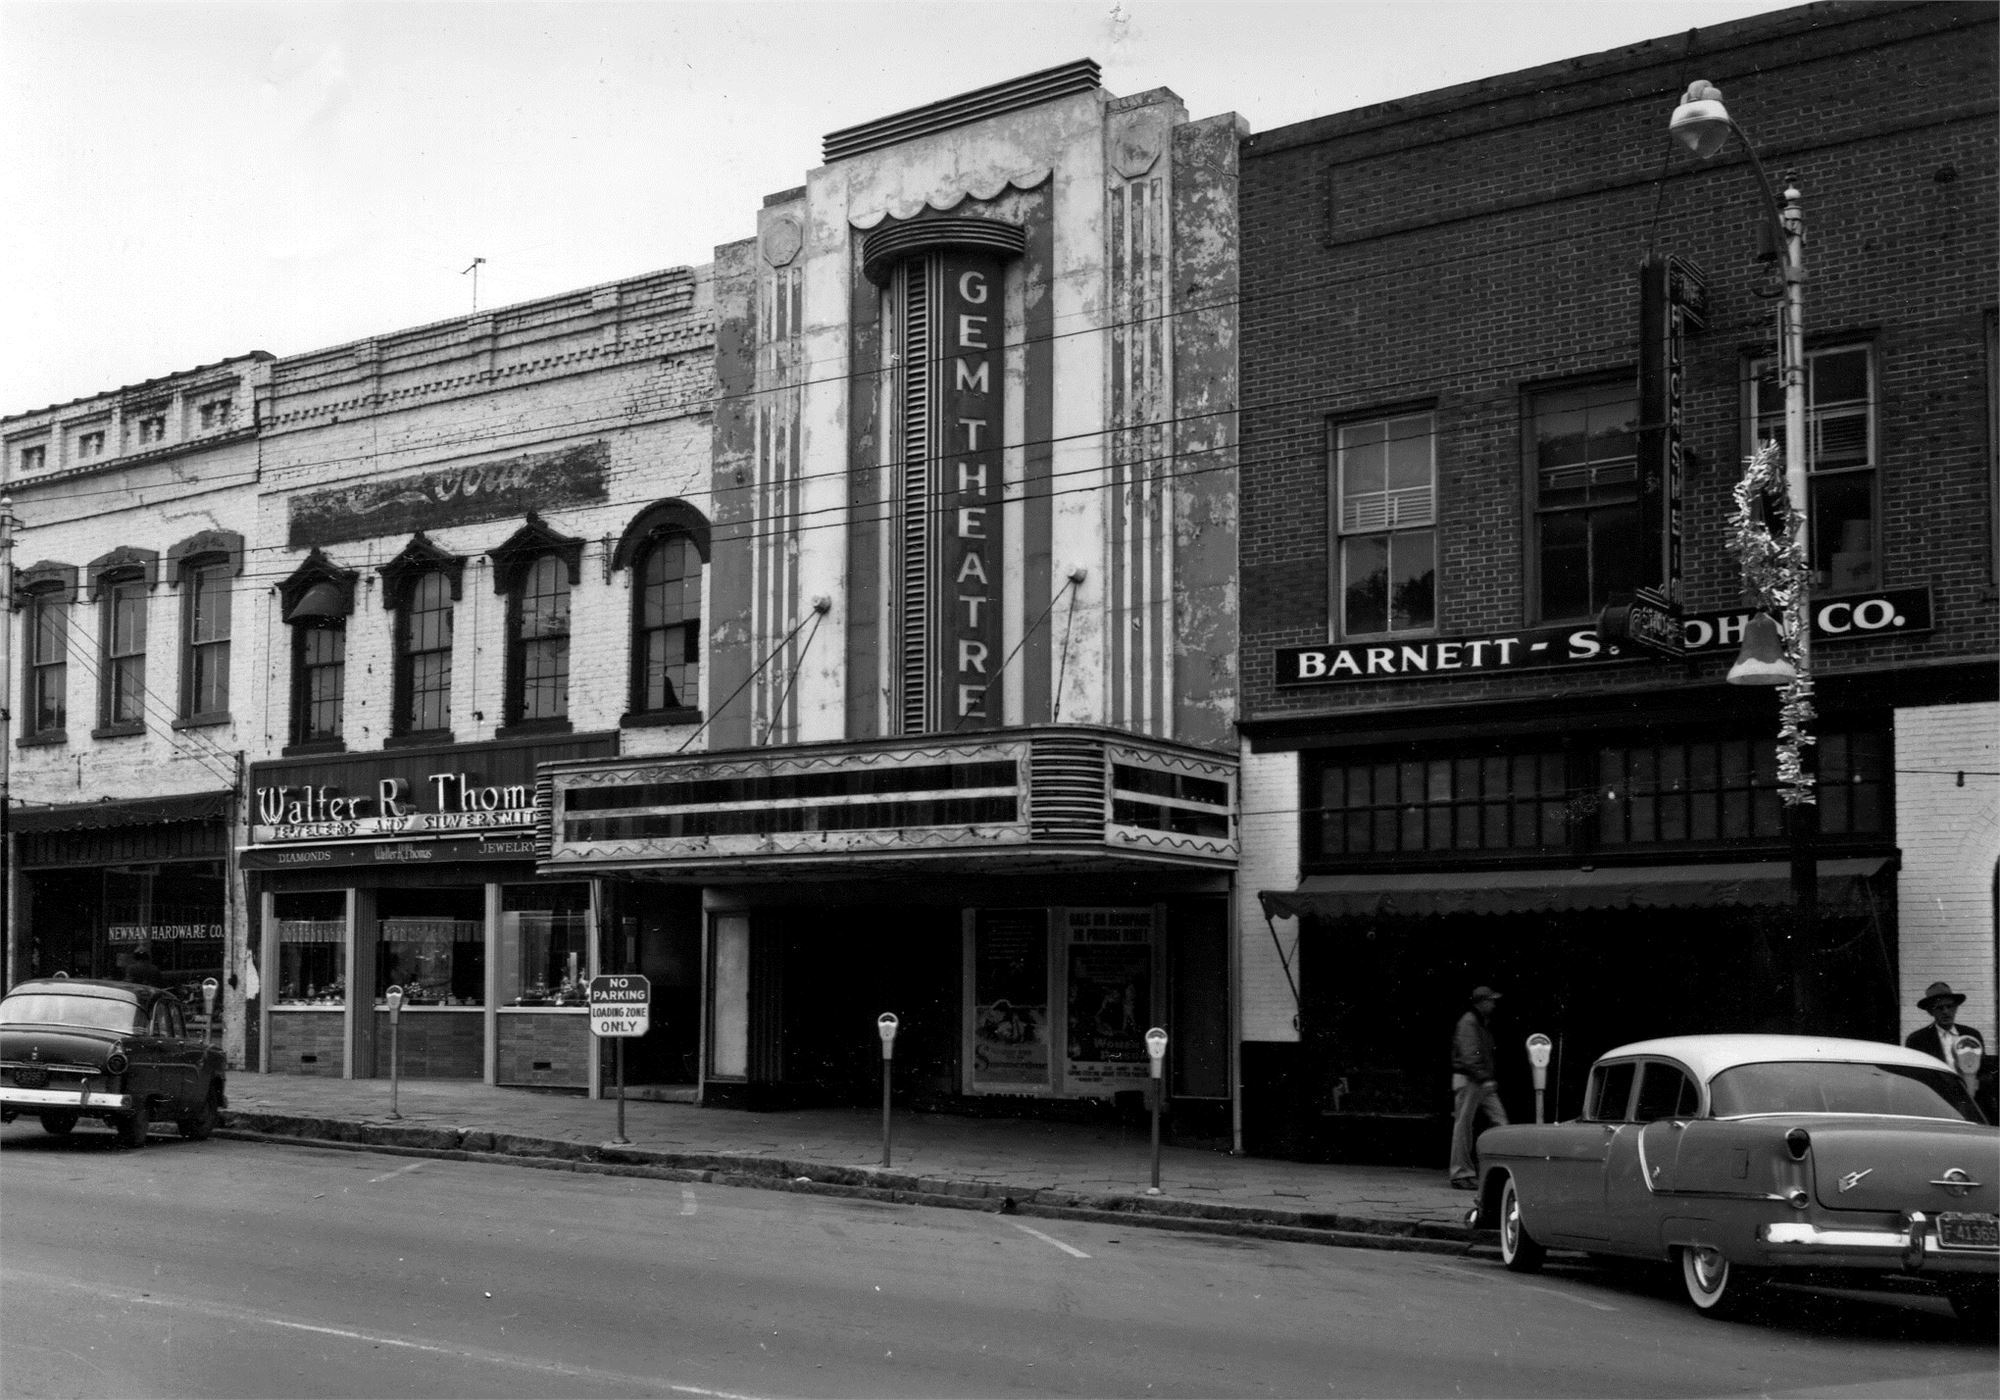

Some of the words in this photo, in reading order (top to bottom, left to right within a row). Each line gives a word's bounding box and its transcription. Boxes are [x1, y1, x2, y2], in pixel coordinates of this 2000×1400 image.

[956, 271, 989, 394] GEM
[957, 418, 988, 718] THEATRE
[1297, 638, 1520, 679] BARNETT
[1817, 599, 1905, 633] CO.
[257, 785, 360, 826] Walter
[429, 773, 538, 812] Thom
[278, 850, 332, 863] DIAMONDS
[479, 841, 536, 855] JEWELRY
[108, 927, 148, 941] NEWNAN
[151, 924, 207, 939] HARDWARE
[209, 924, 225, 938] CO.
[609, 978, 629, 988] NO
[593, 990, 646, 1001] PARKING
[592, 1008, 624, 1018] LOADING
[626, 1007, 646, 1017] ZONE
[601, 1021, 637, 1032] ONLY
